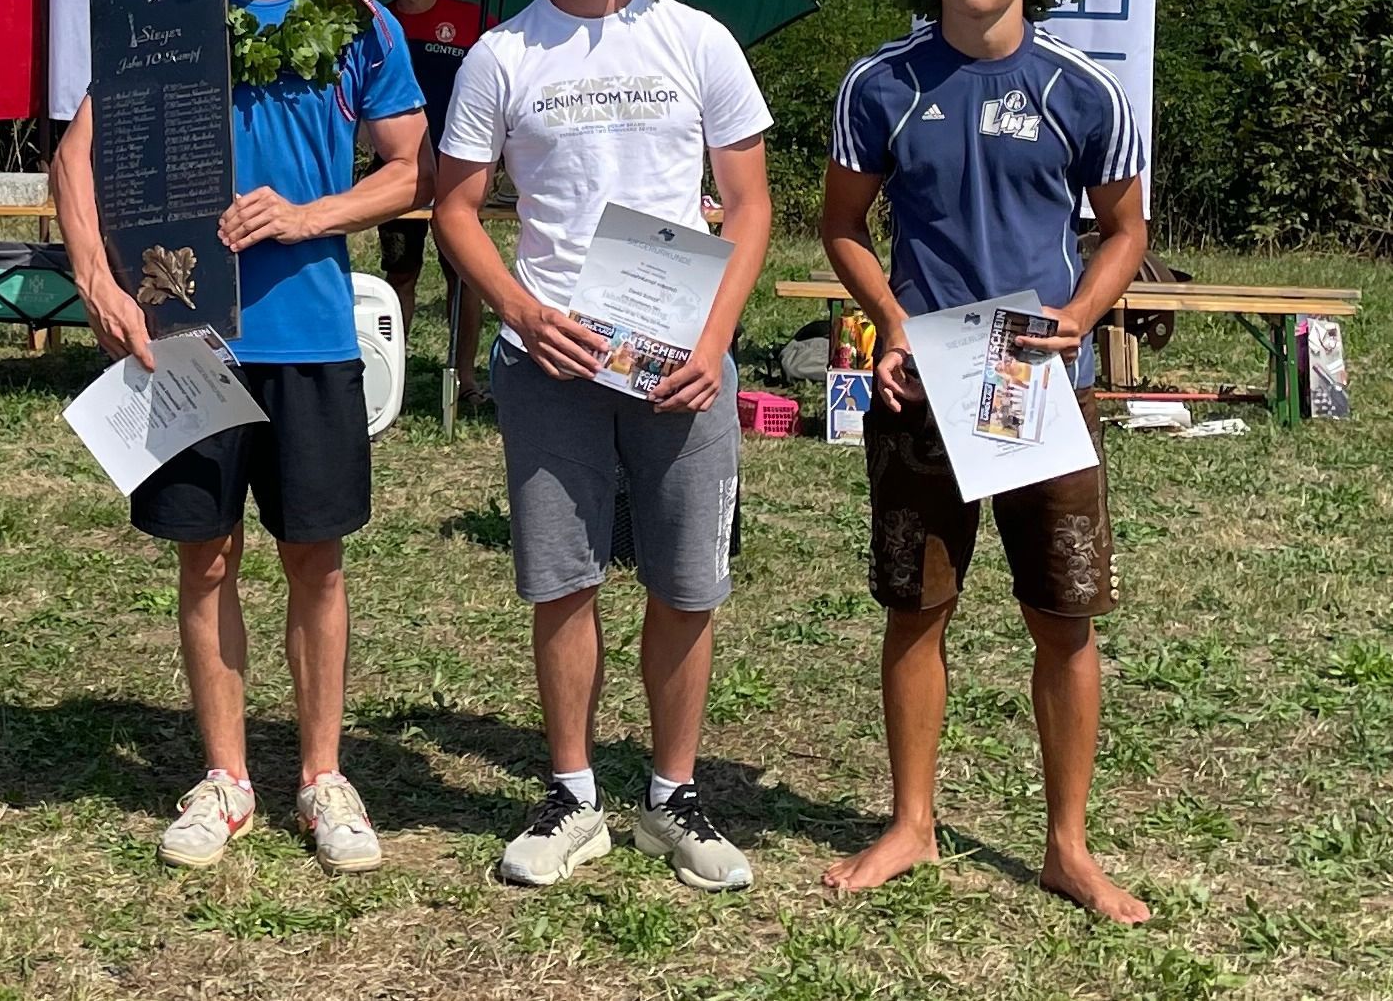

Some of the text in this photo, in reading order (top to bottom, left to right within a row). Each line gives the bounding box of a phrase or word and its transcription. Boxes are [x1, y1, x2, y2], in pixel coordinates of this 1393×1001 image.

[532, 90, 679, 113] DENIM TOM TAILOR
